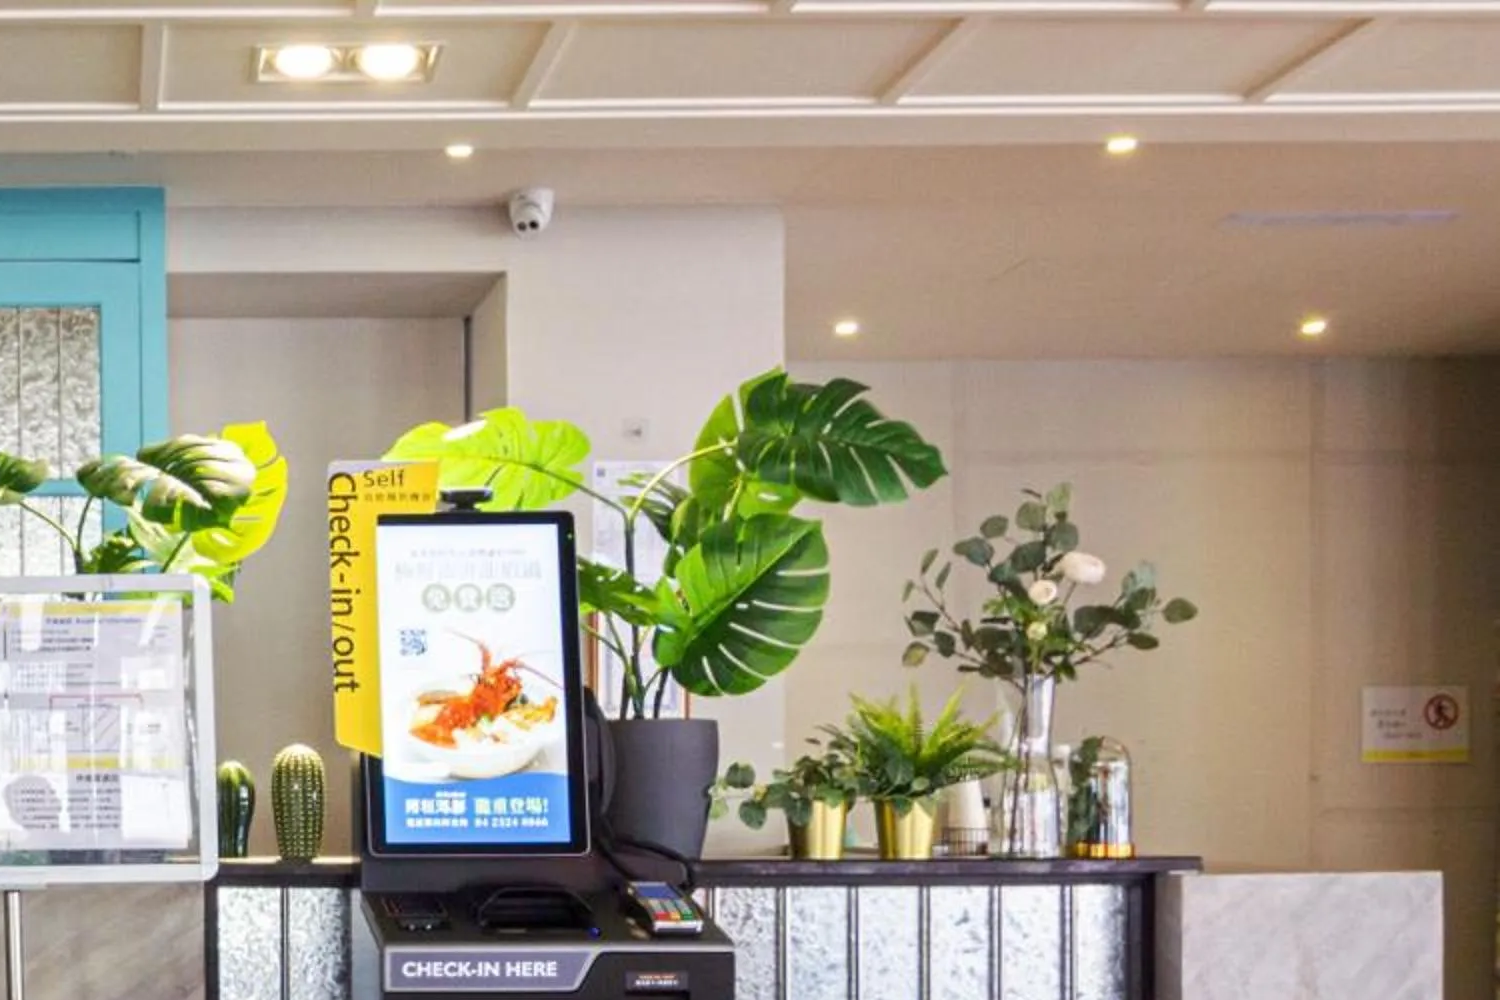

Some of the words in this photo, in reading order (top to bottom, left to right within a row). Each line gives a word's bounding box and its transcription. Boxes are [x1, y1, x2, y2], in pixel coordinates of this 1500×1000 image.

[363, 469, 405, 488] Self
[328, 472, 362, 694] Check-in/out
[402, 961, 500, 977] CHECK-IN
[505, 961, 558, 977] HERE
